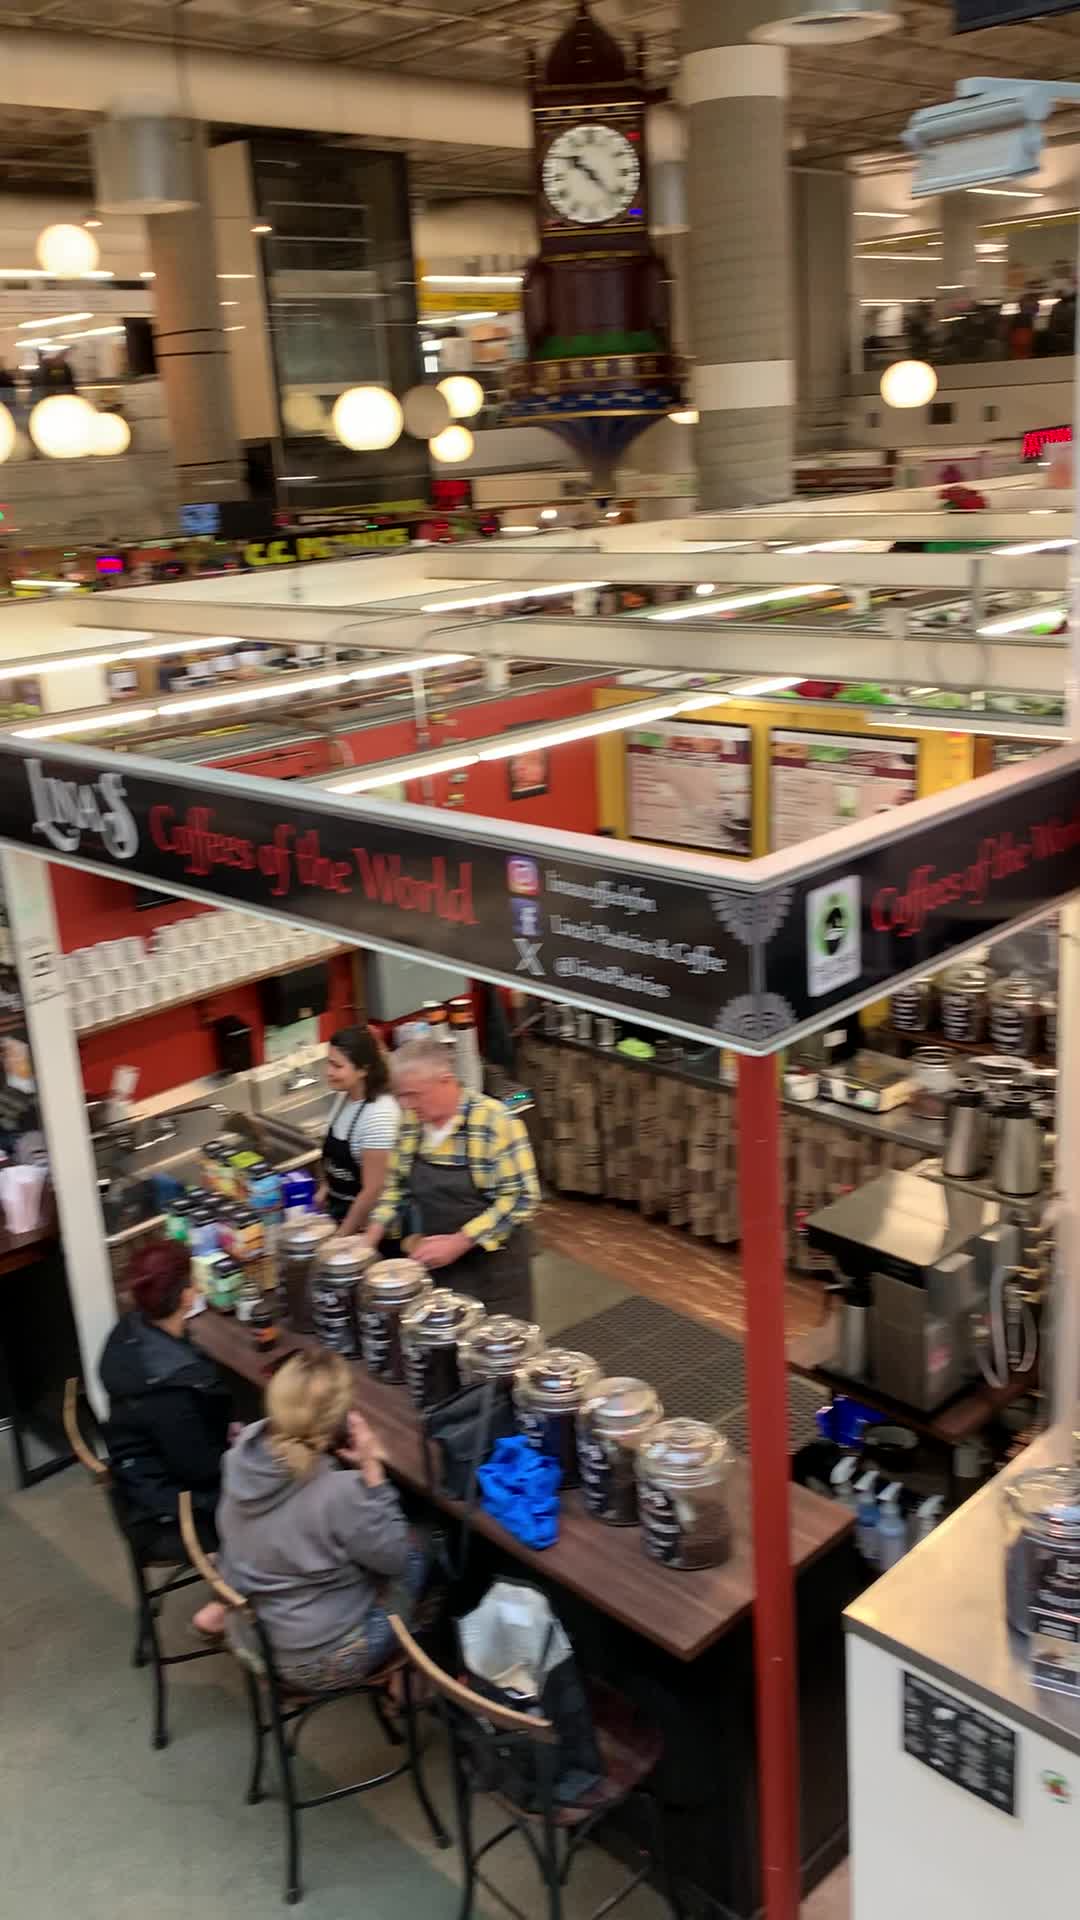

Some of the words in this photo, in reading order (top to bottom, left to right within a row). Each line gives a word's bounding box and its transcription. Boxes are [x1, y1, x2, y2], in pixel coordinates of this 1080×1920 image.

[149, 804, 255, 876] Coffees
[258, 824, 297, 896] of
[296, 830, 352, 894] the
[352, 848, 480, 925] World
[871, 864, 961, 937] Coffees
